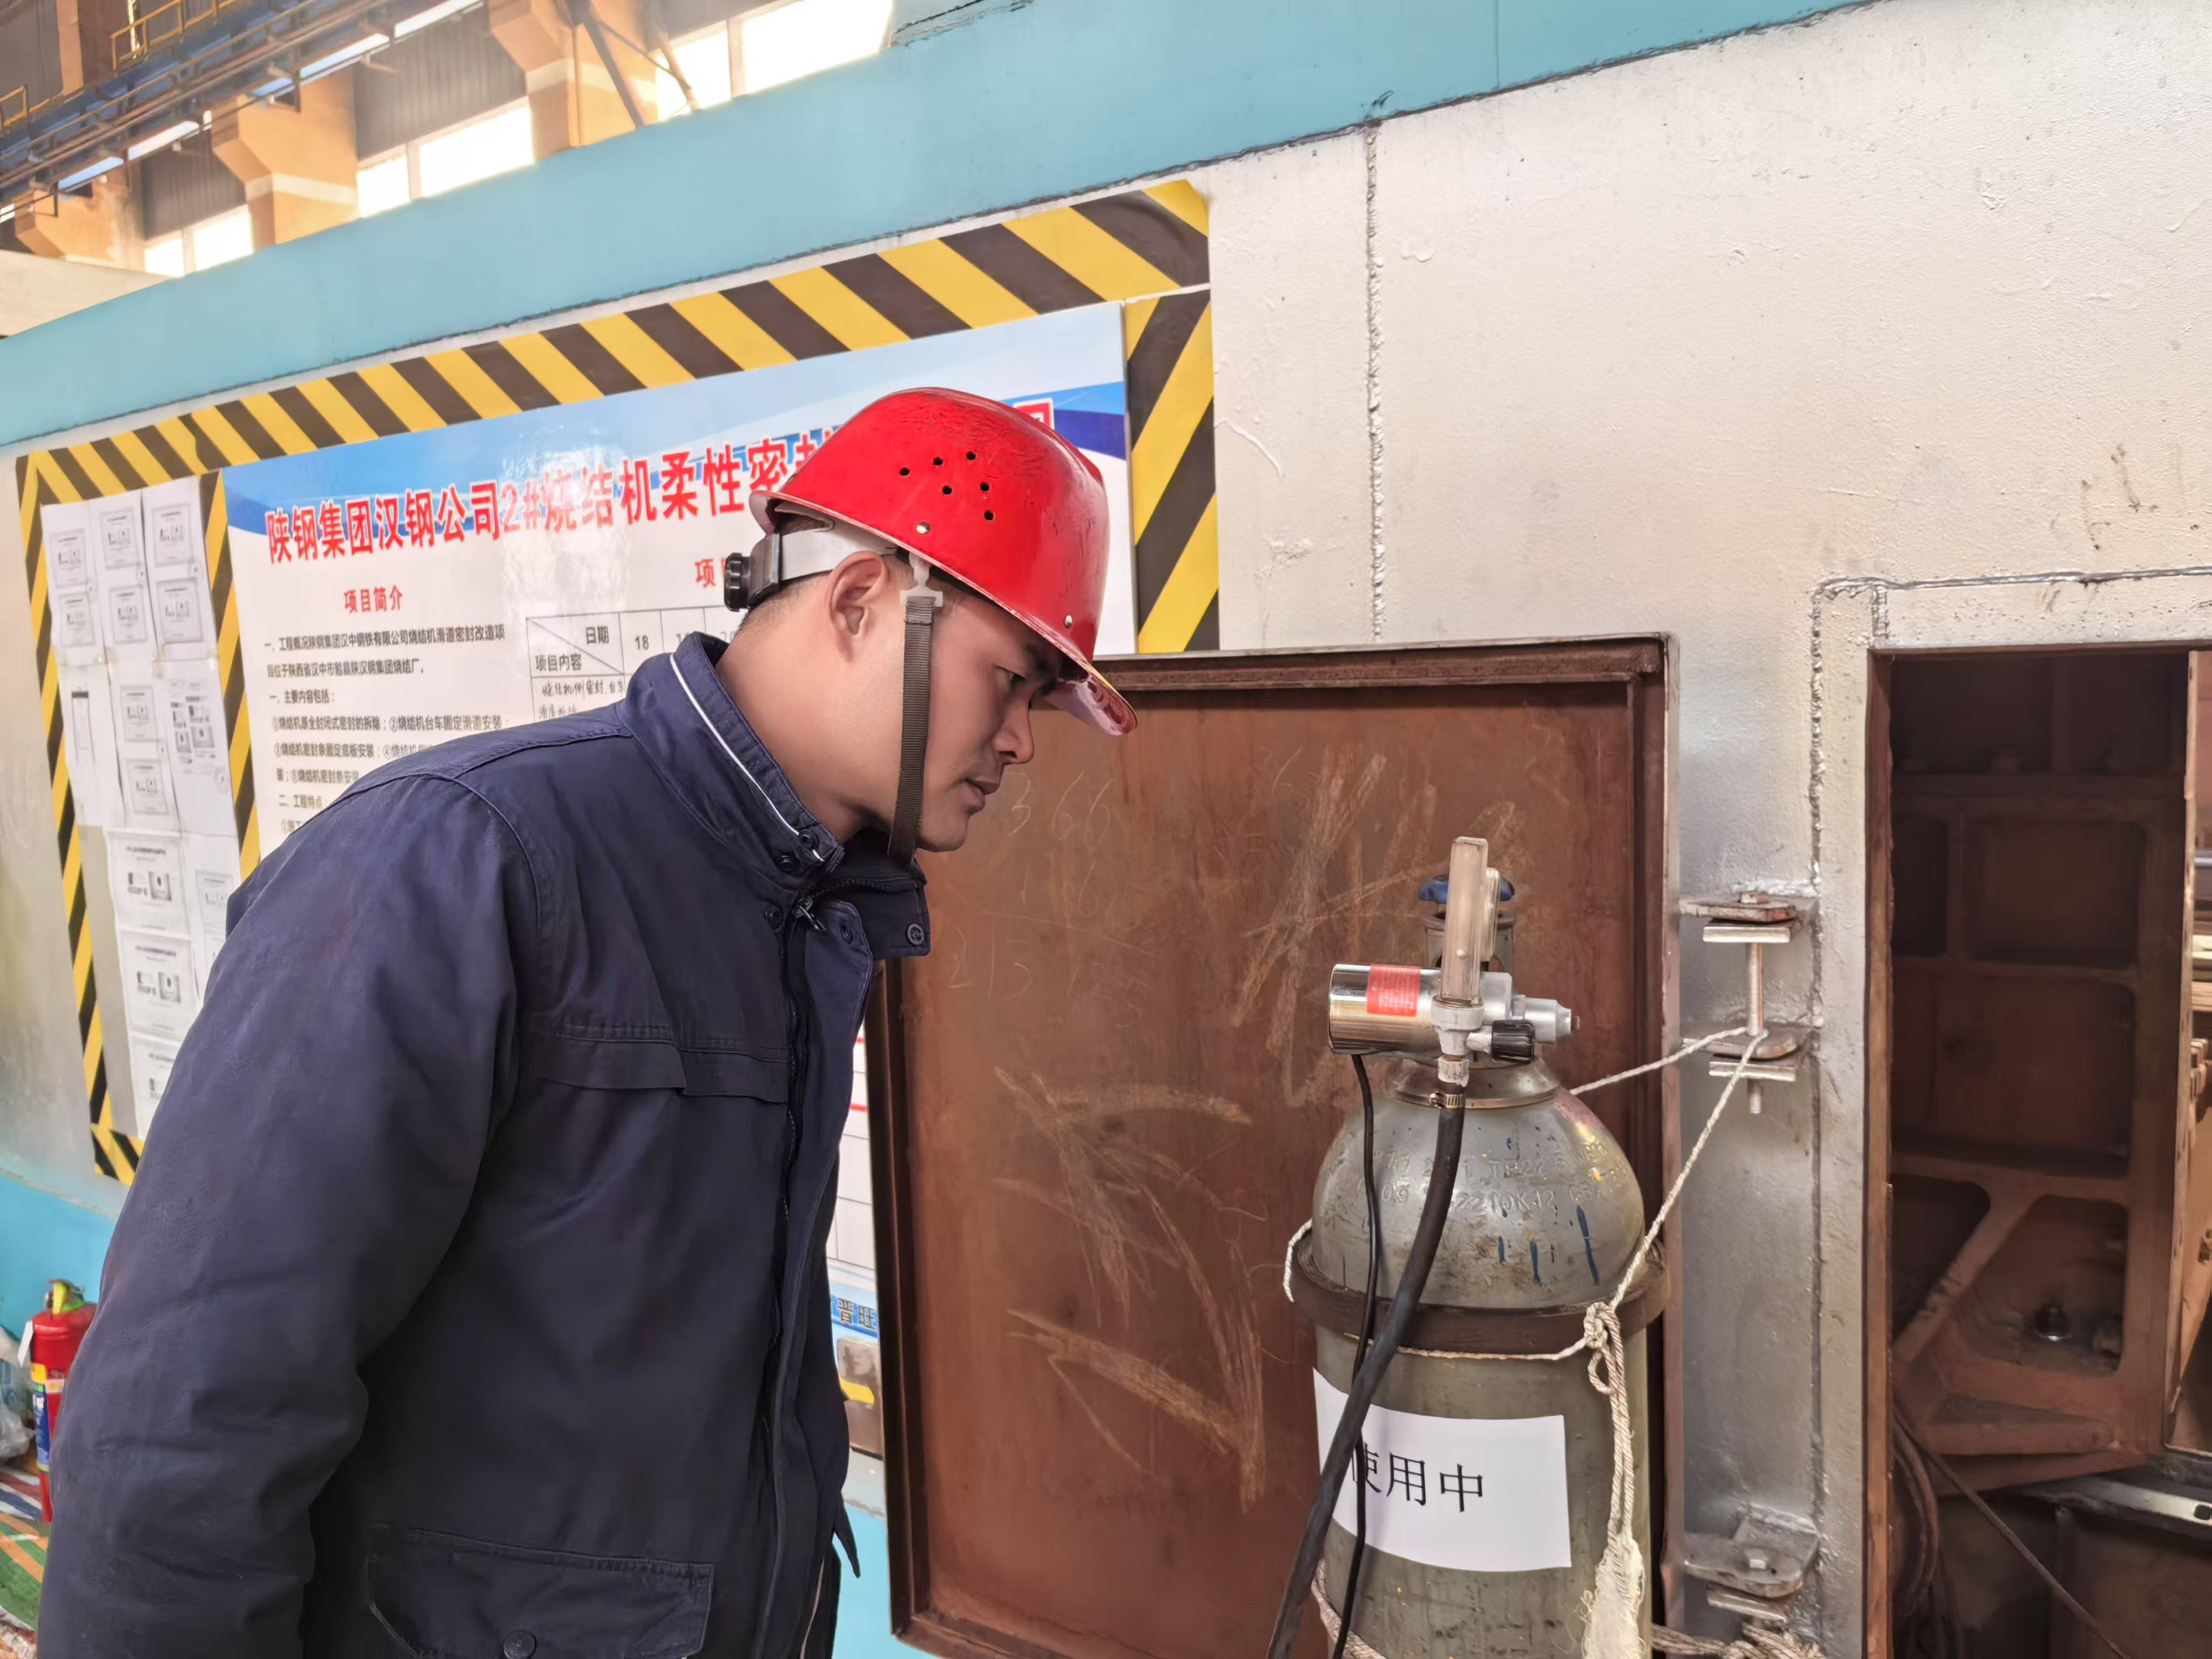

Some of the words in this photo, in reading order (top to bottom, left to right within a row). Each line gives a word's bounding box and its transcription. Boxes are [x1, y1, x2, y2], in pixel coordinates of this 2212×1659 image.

[694, 557, 724, 589] 项
[343, 585, 403, 613] 项目简介
[586, 626, 610, 645] 日期
[635, 636, 649, 650] 18
[535, 653, 582, 671] 项目内容
